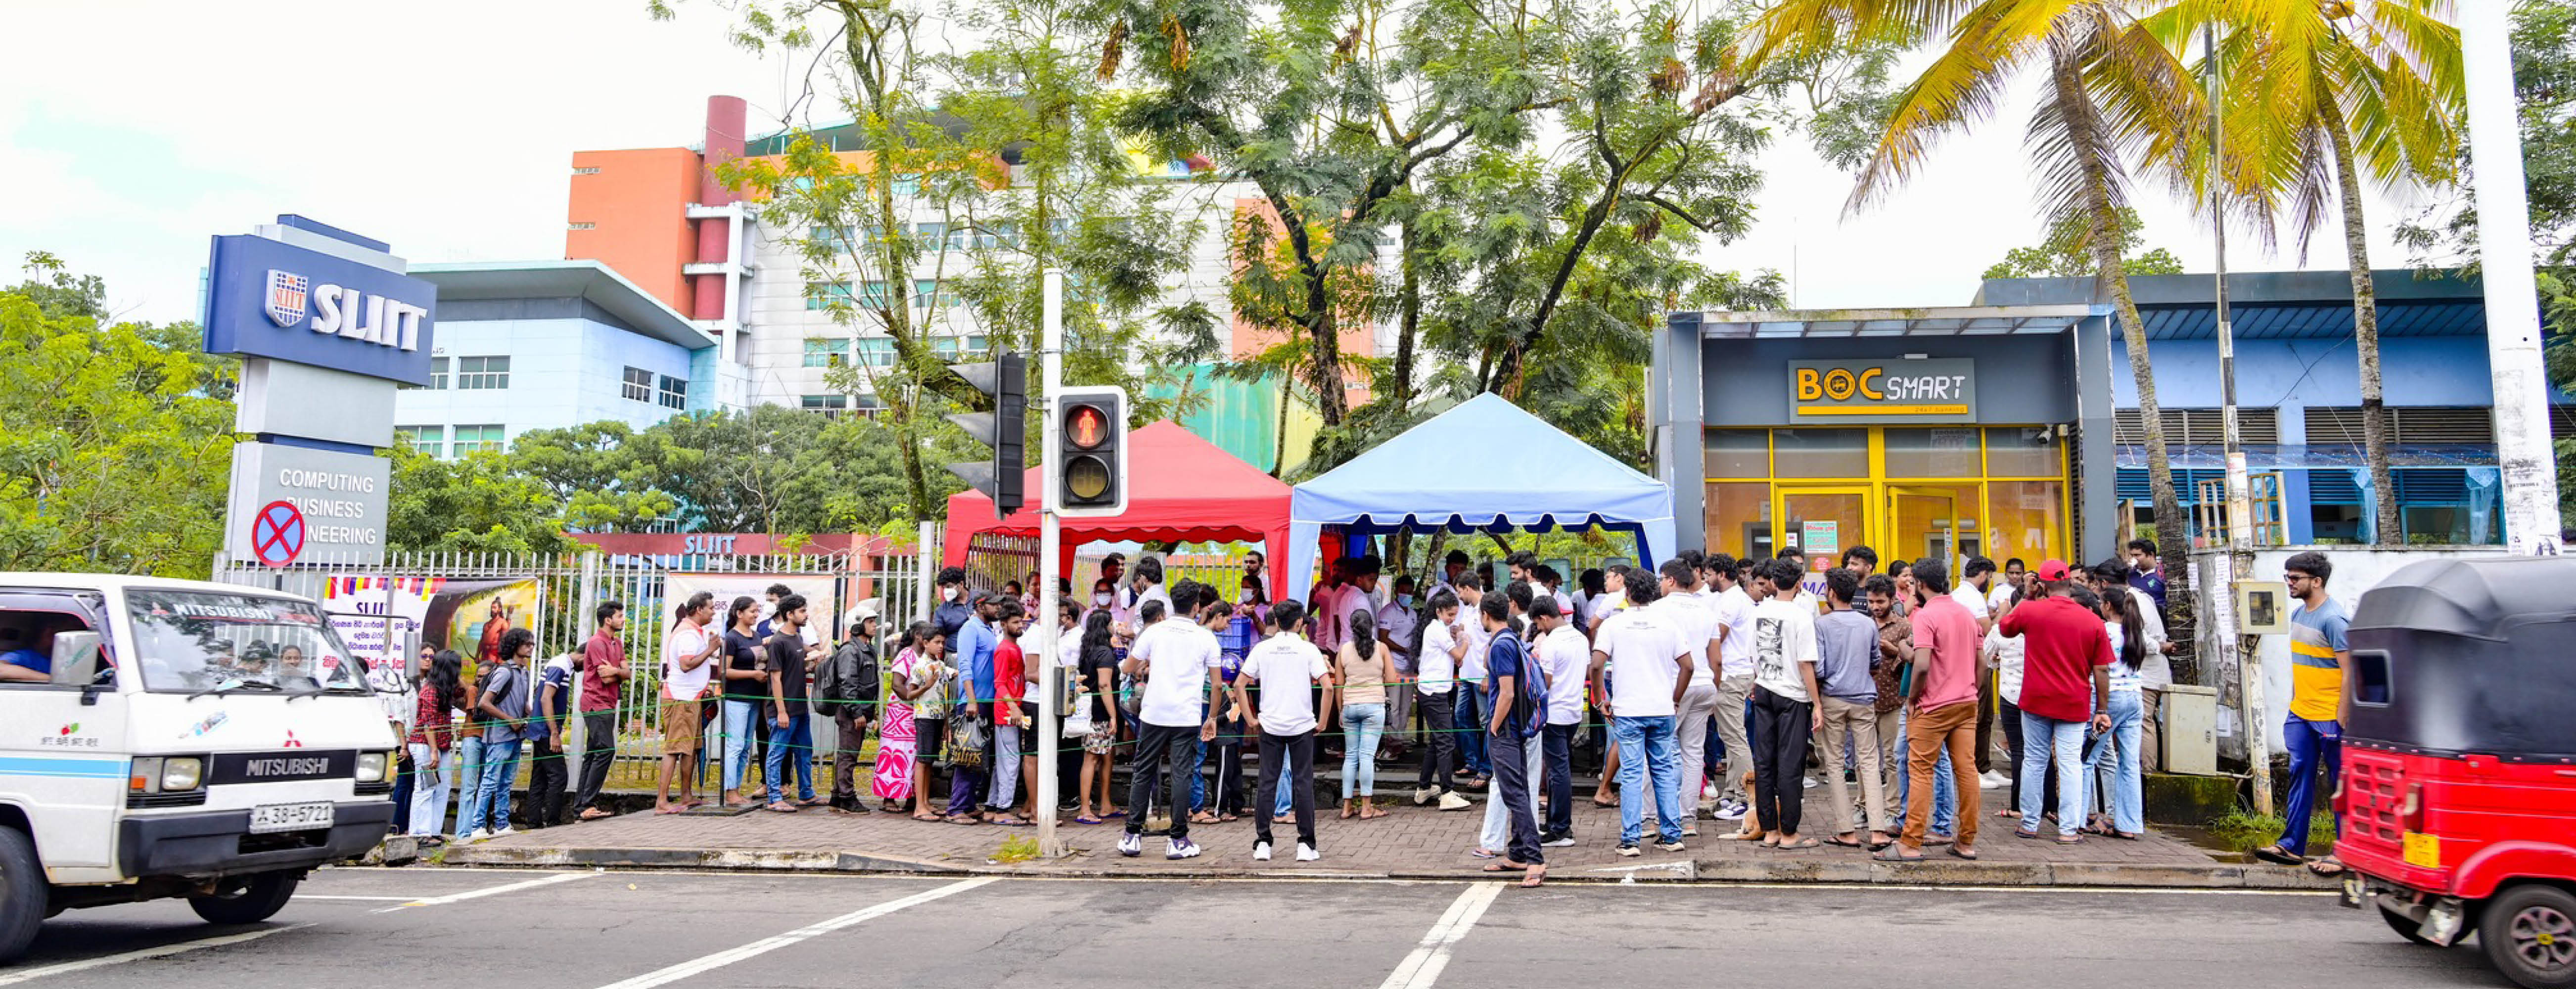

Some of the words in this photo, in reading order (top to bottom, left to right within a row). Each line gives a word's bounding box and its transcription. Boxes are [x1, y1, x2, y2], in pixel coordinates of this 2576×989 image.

[311, 284, 428, 351] SLIIT
[1797, 367, 1883, 401] BOC
[1886, 376, 1966, 401] SMART
[280, 468, 374, 494] COMPUTING
[304, 525, 376, 544] INEERING
[684, 536, 736, 553] SLIIT
[173, 604, 275, 620] MITSUBISHI
[246, 758, 328, 776] MITSUBISHI
